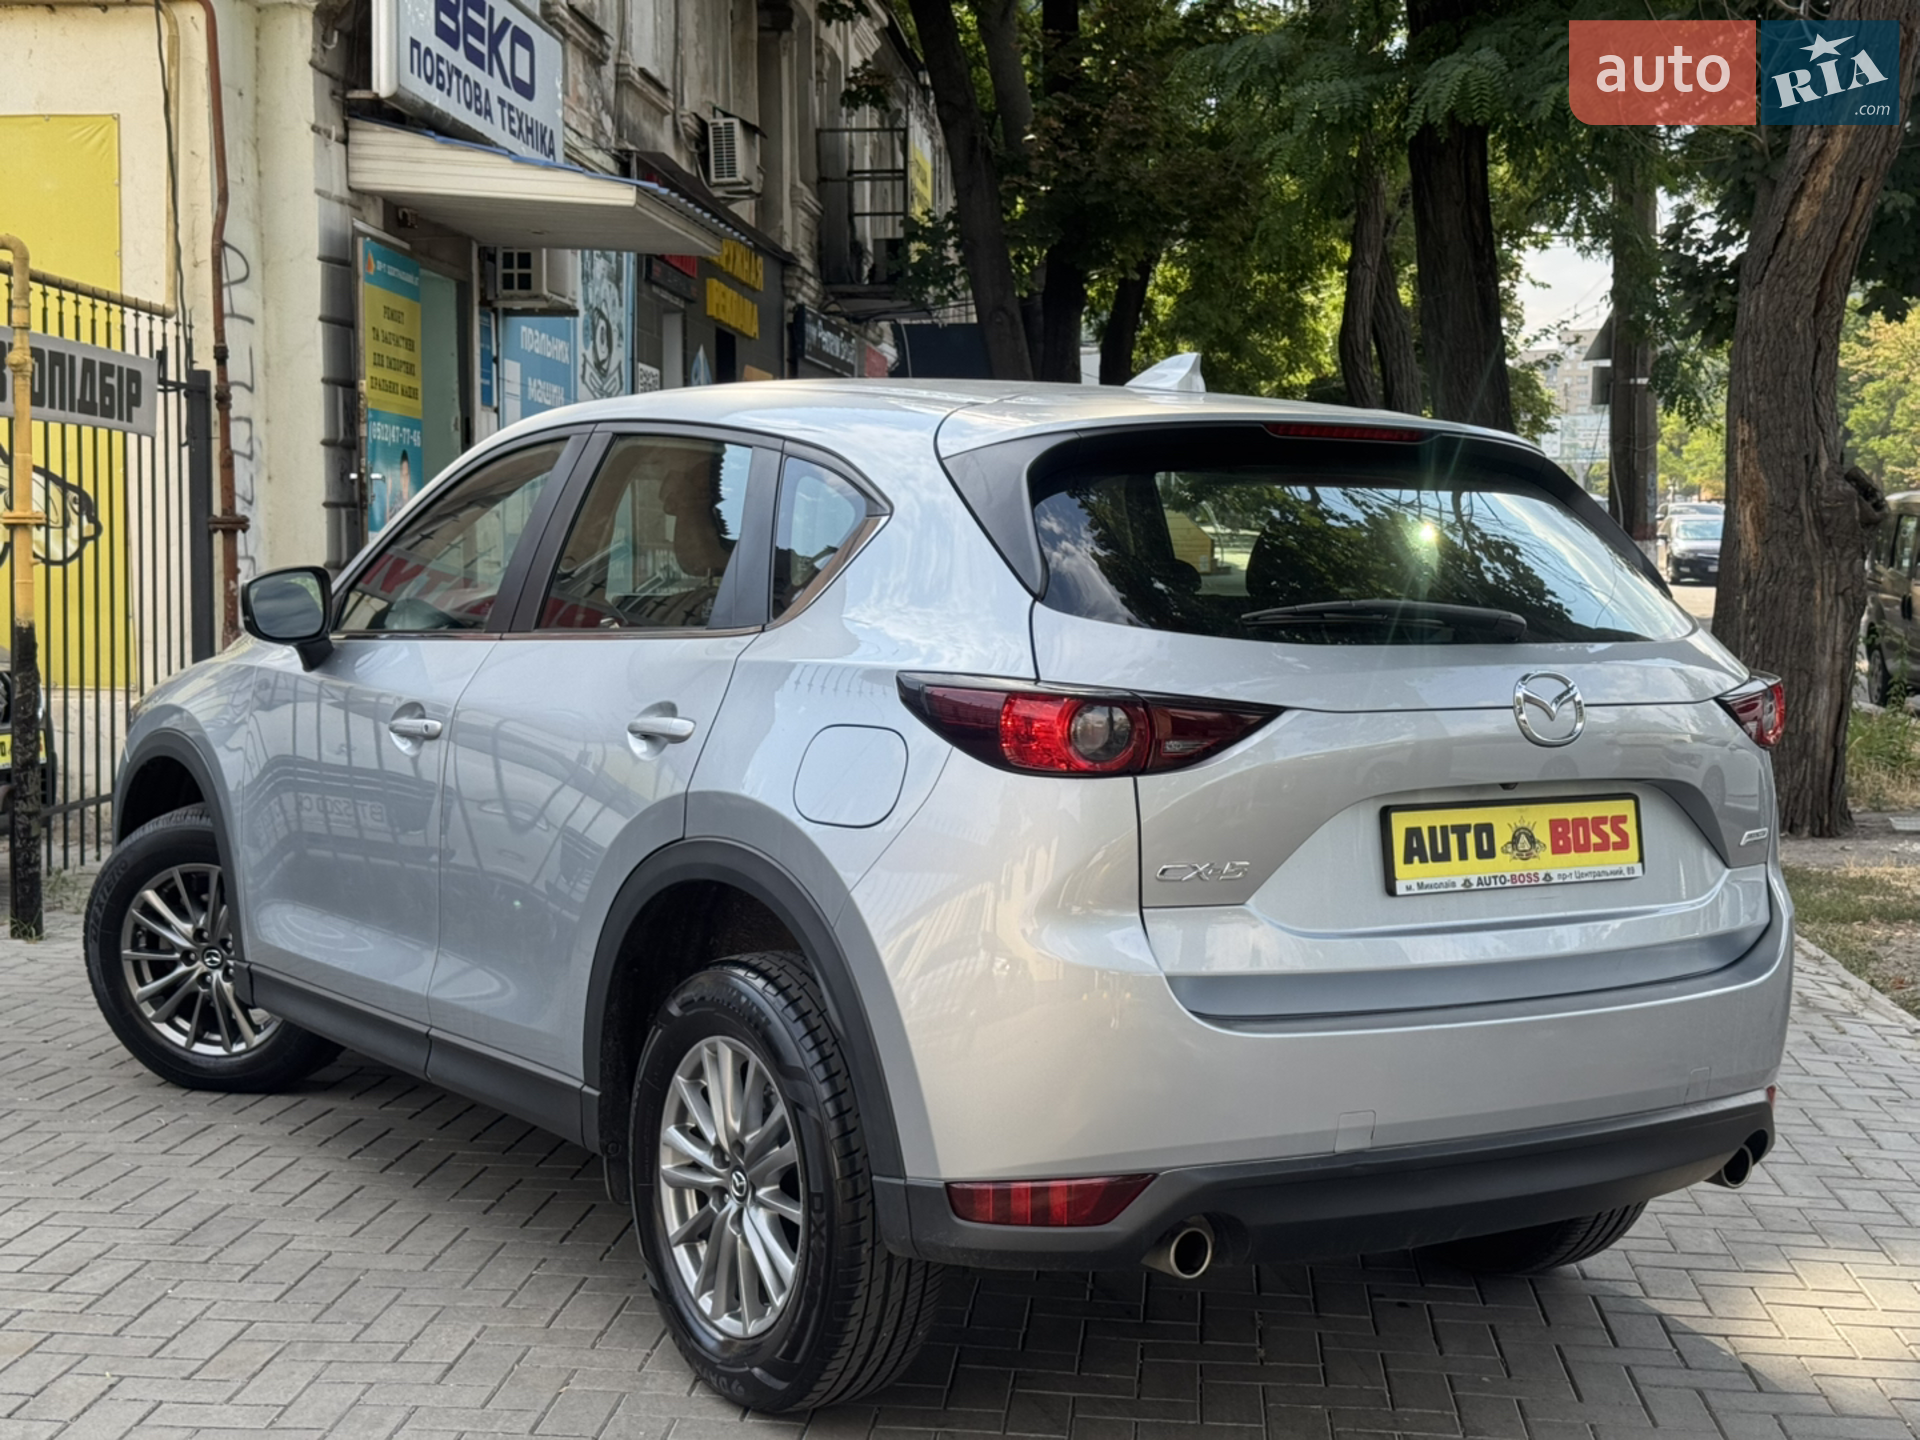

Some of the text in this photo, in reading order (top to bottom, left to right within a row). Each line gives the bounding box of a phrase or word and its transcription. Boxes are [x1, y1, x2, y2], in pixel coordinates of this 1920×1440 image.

[435, 0, 535, 102] BEKO
[410, 36, 556, 162] ПОБУТОВА ТЕХНІКА
[521, 325, 570, 365] пральних
[527, 376, 565, 407] машин
[1403, 815, 1630, 865] AUTO BOSS
[1156, 861, 1250, 881] CX-5
[1476, 872, 1540, 888] AUTO-BOSS
